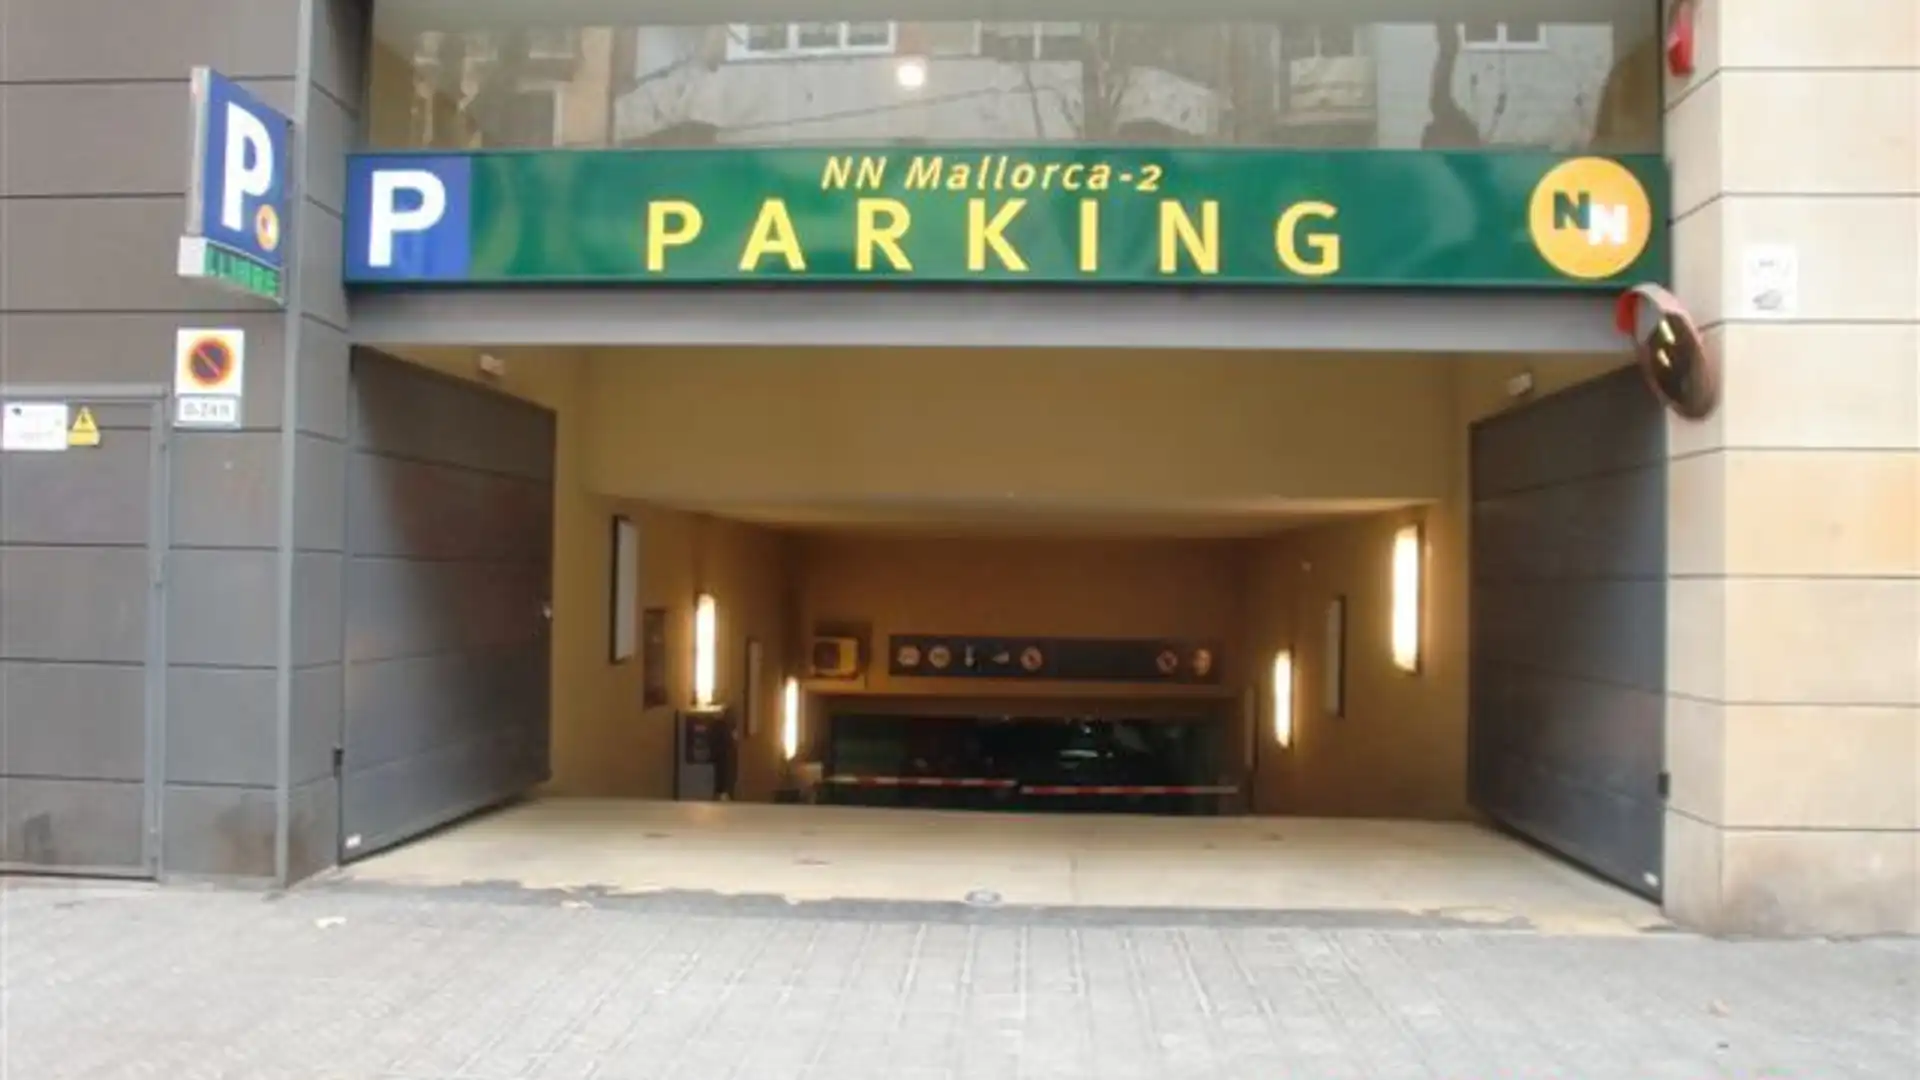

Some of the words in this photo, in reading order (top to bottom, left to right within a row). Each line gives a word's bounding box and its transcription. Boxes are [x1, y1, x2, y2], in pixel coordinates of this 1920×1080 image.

[221, 100, 274, 232] P
[820, 156, 888, 191] NN
[904, 156, 1163, 192] Mallorca-2
[368, 169, 446, 268] P
[648, 197, 1341, 275] PARKING
[1553, 190, 1629, 246] NN
